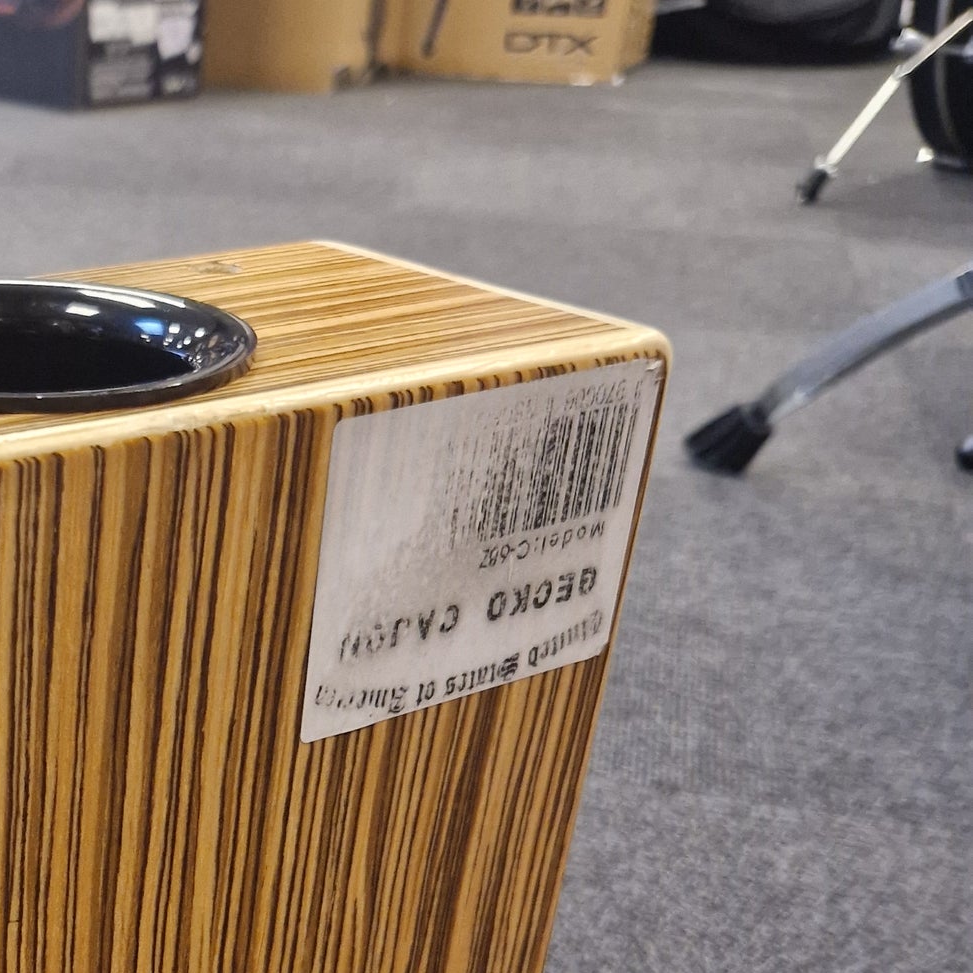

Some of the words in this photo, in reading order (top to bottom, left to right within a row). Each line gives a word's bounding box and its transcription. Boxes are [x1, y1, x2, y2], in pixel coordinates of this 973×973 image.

[504, 32, 600, 56] DTX
[486, 566, 598, 622] GECKO
[528, 609, 604, 667] United
[416, 680, 436, 706] of
[444, 652, 520, 697] States
